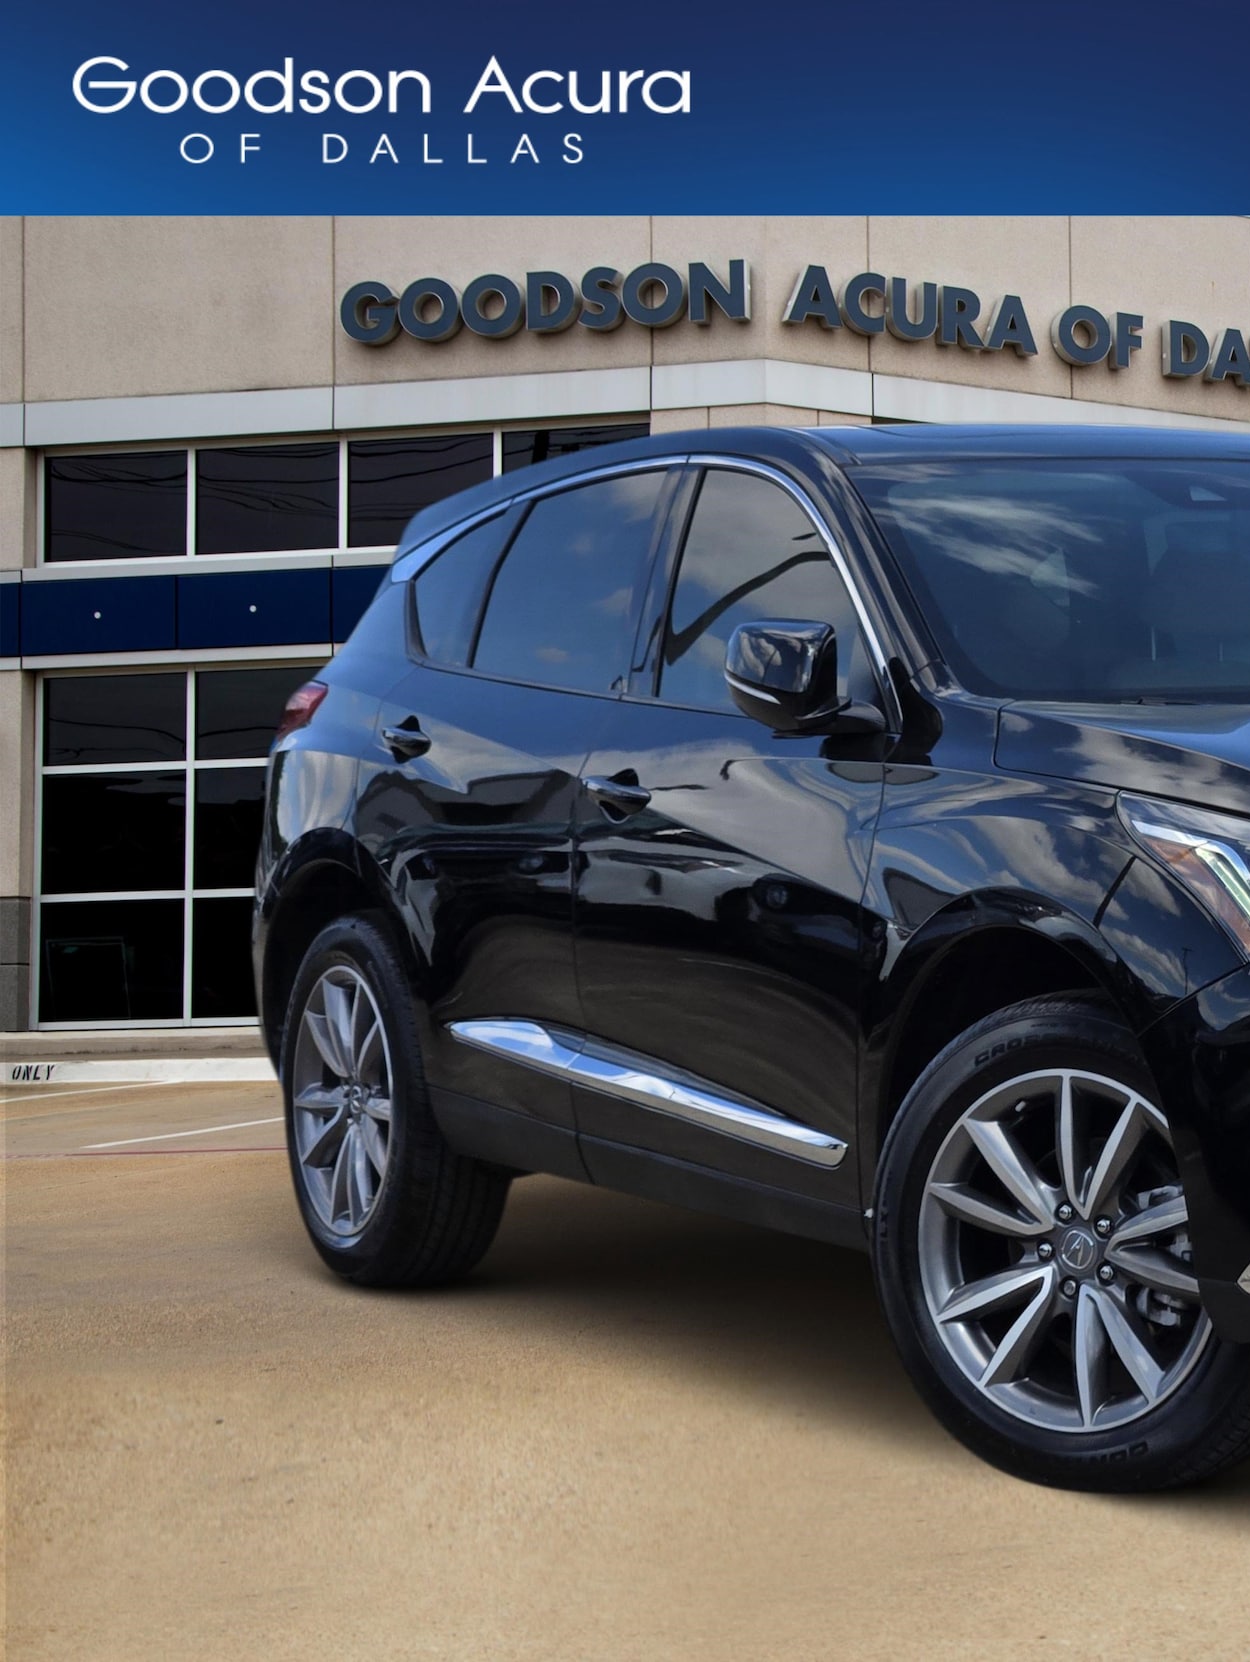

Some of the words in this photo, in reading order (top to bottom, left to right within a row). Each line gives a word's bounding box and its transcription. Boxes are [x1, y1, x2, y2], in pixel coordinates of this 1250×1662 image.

[340, 259, 752, 346] GOODSON
[782, 264, 1039, 358] ACURA
[1052, 304, 1145, 371] OF
[11, 1065, 55, 1081] ONLY
